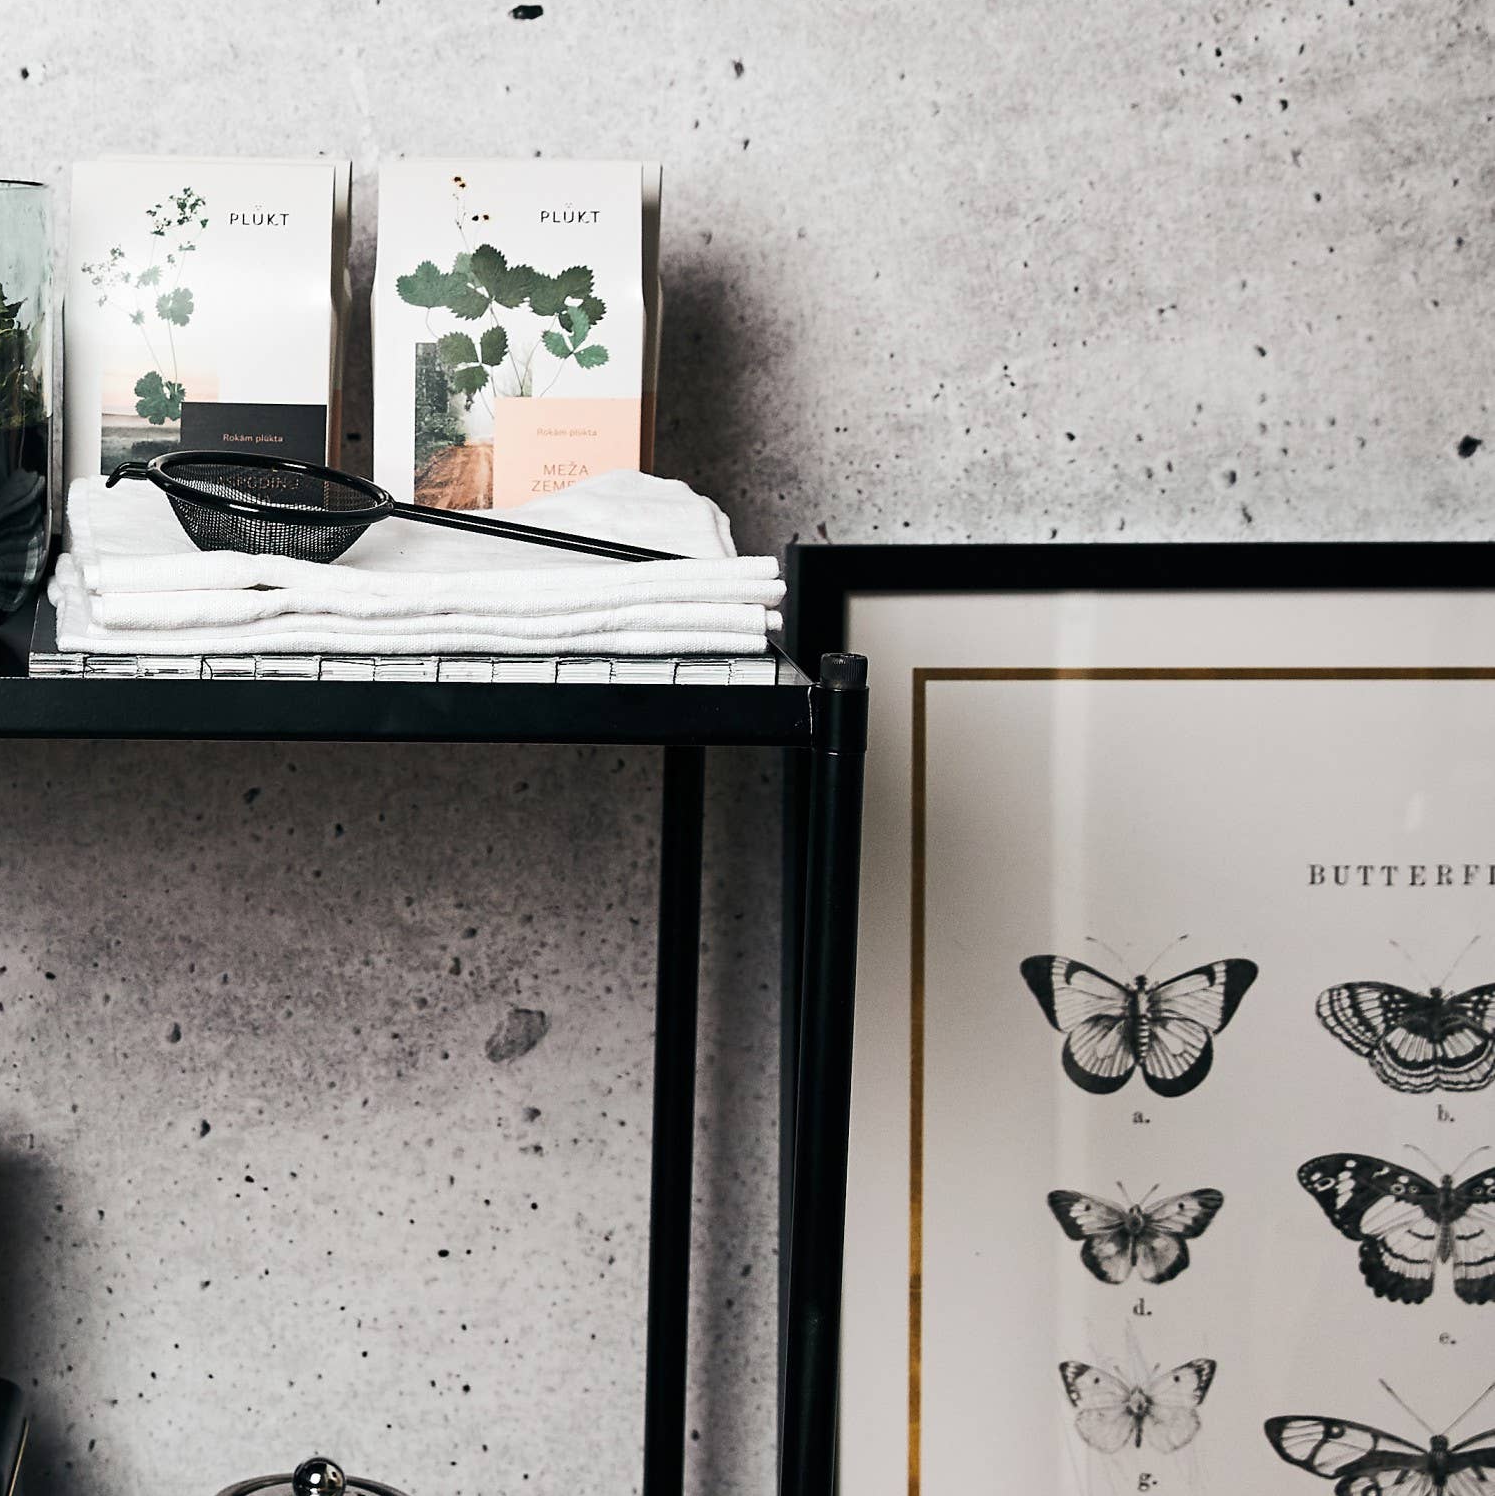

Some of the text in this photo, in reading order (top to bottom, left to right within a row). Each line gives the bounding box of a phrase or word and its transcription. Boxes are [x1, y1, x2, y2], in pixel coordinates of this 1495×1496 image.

[542, 461, 590, 476] MEŽA
[1132, 1111, 1151, 1124] a.
[1437, 1104, 1455, 1123] b.
[1132, 1297, 1153, 1316] d.
[1137, 1472, 1158, 1491] g.
